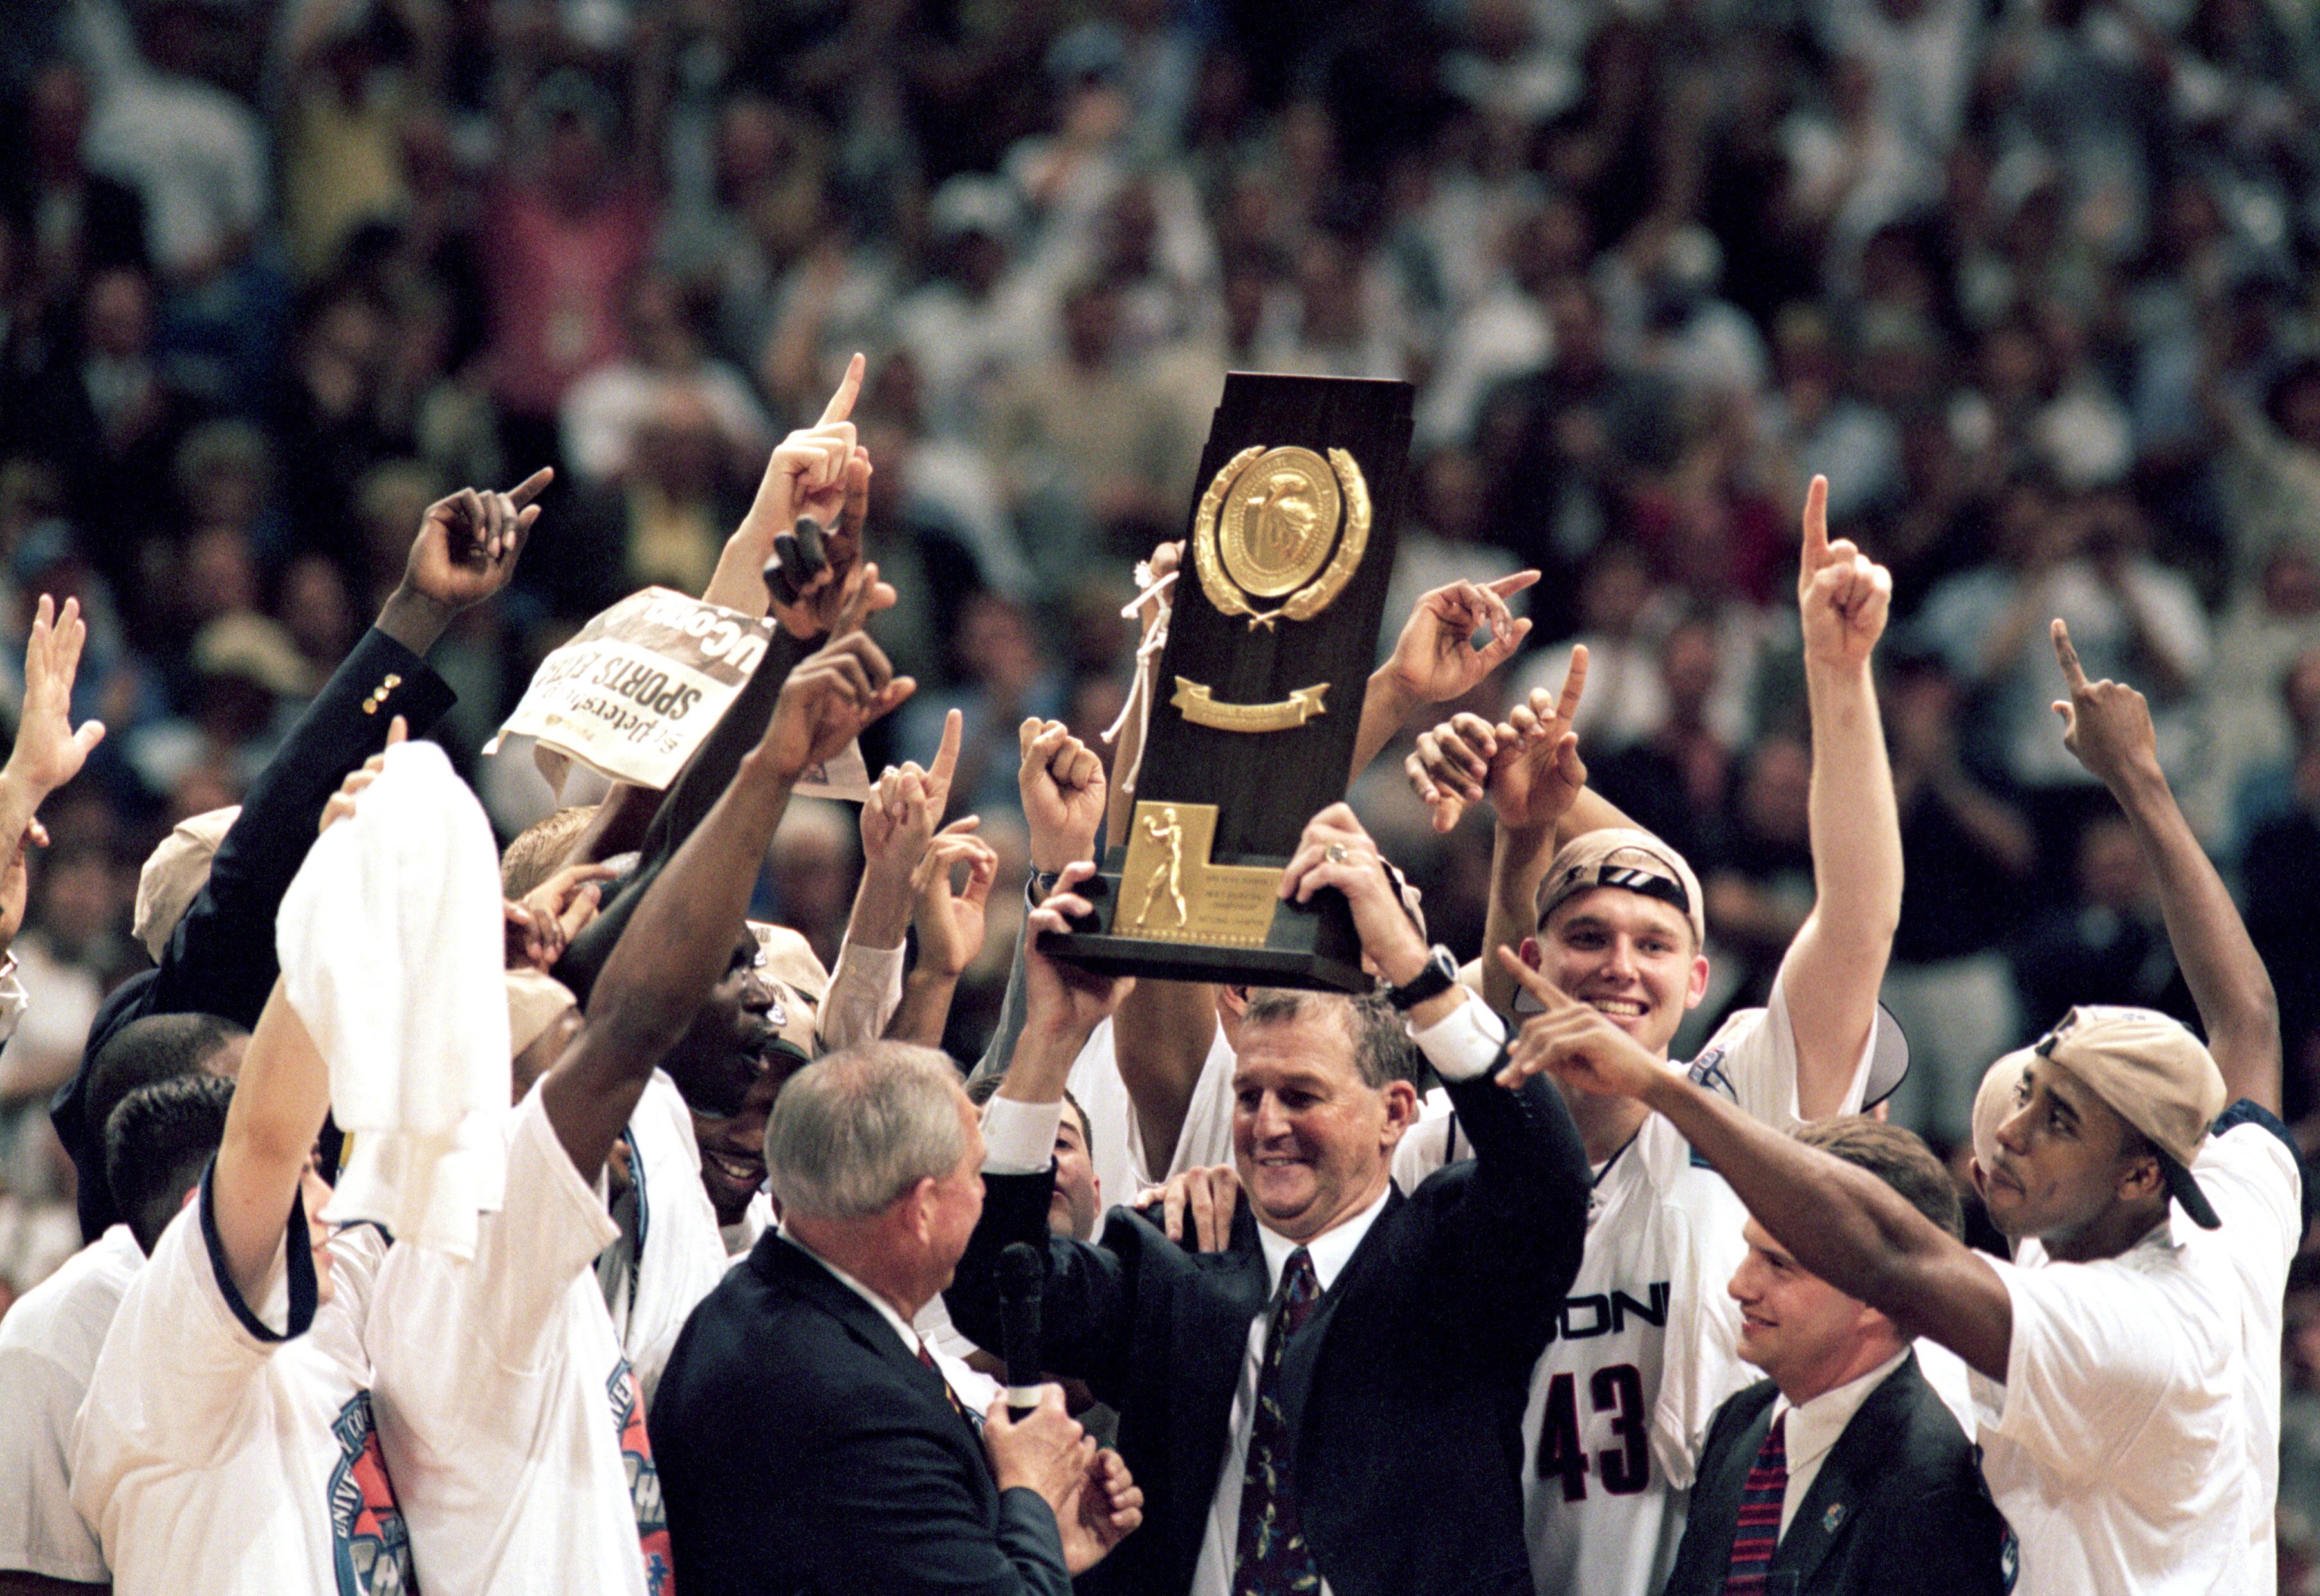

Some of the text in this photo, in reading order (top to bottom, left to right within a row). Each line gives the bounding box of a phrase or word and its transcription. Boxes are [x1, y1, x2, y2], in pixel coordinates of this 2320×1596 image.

[643, 605, 769, 675] UConn
[591, 656, 702, 721] SPORTS
[1538, 1363, 1650, 1503] 43
